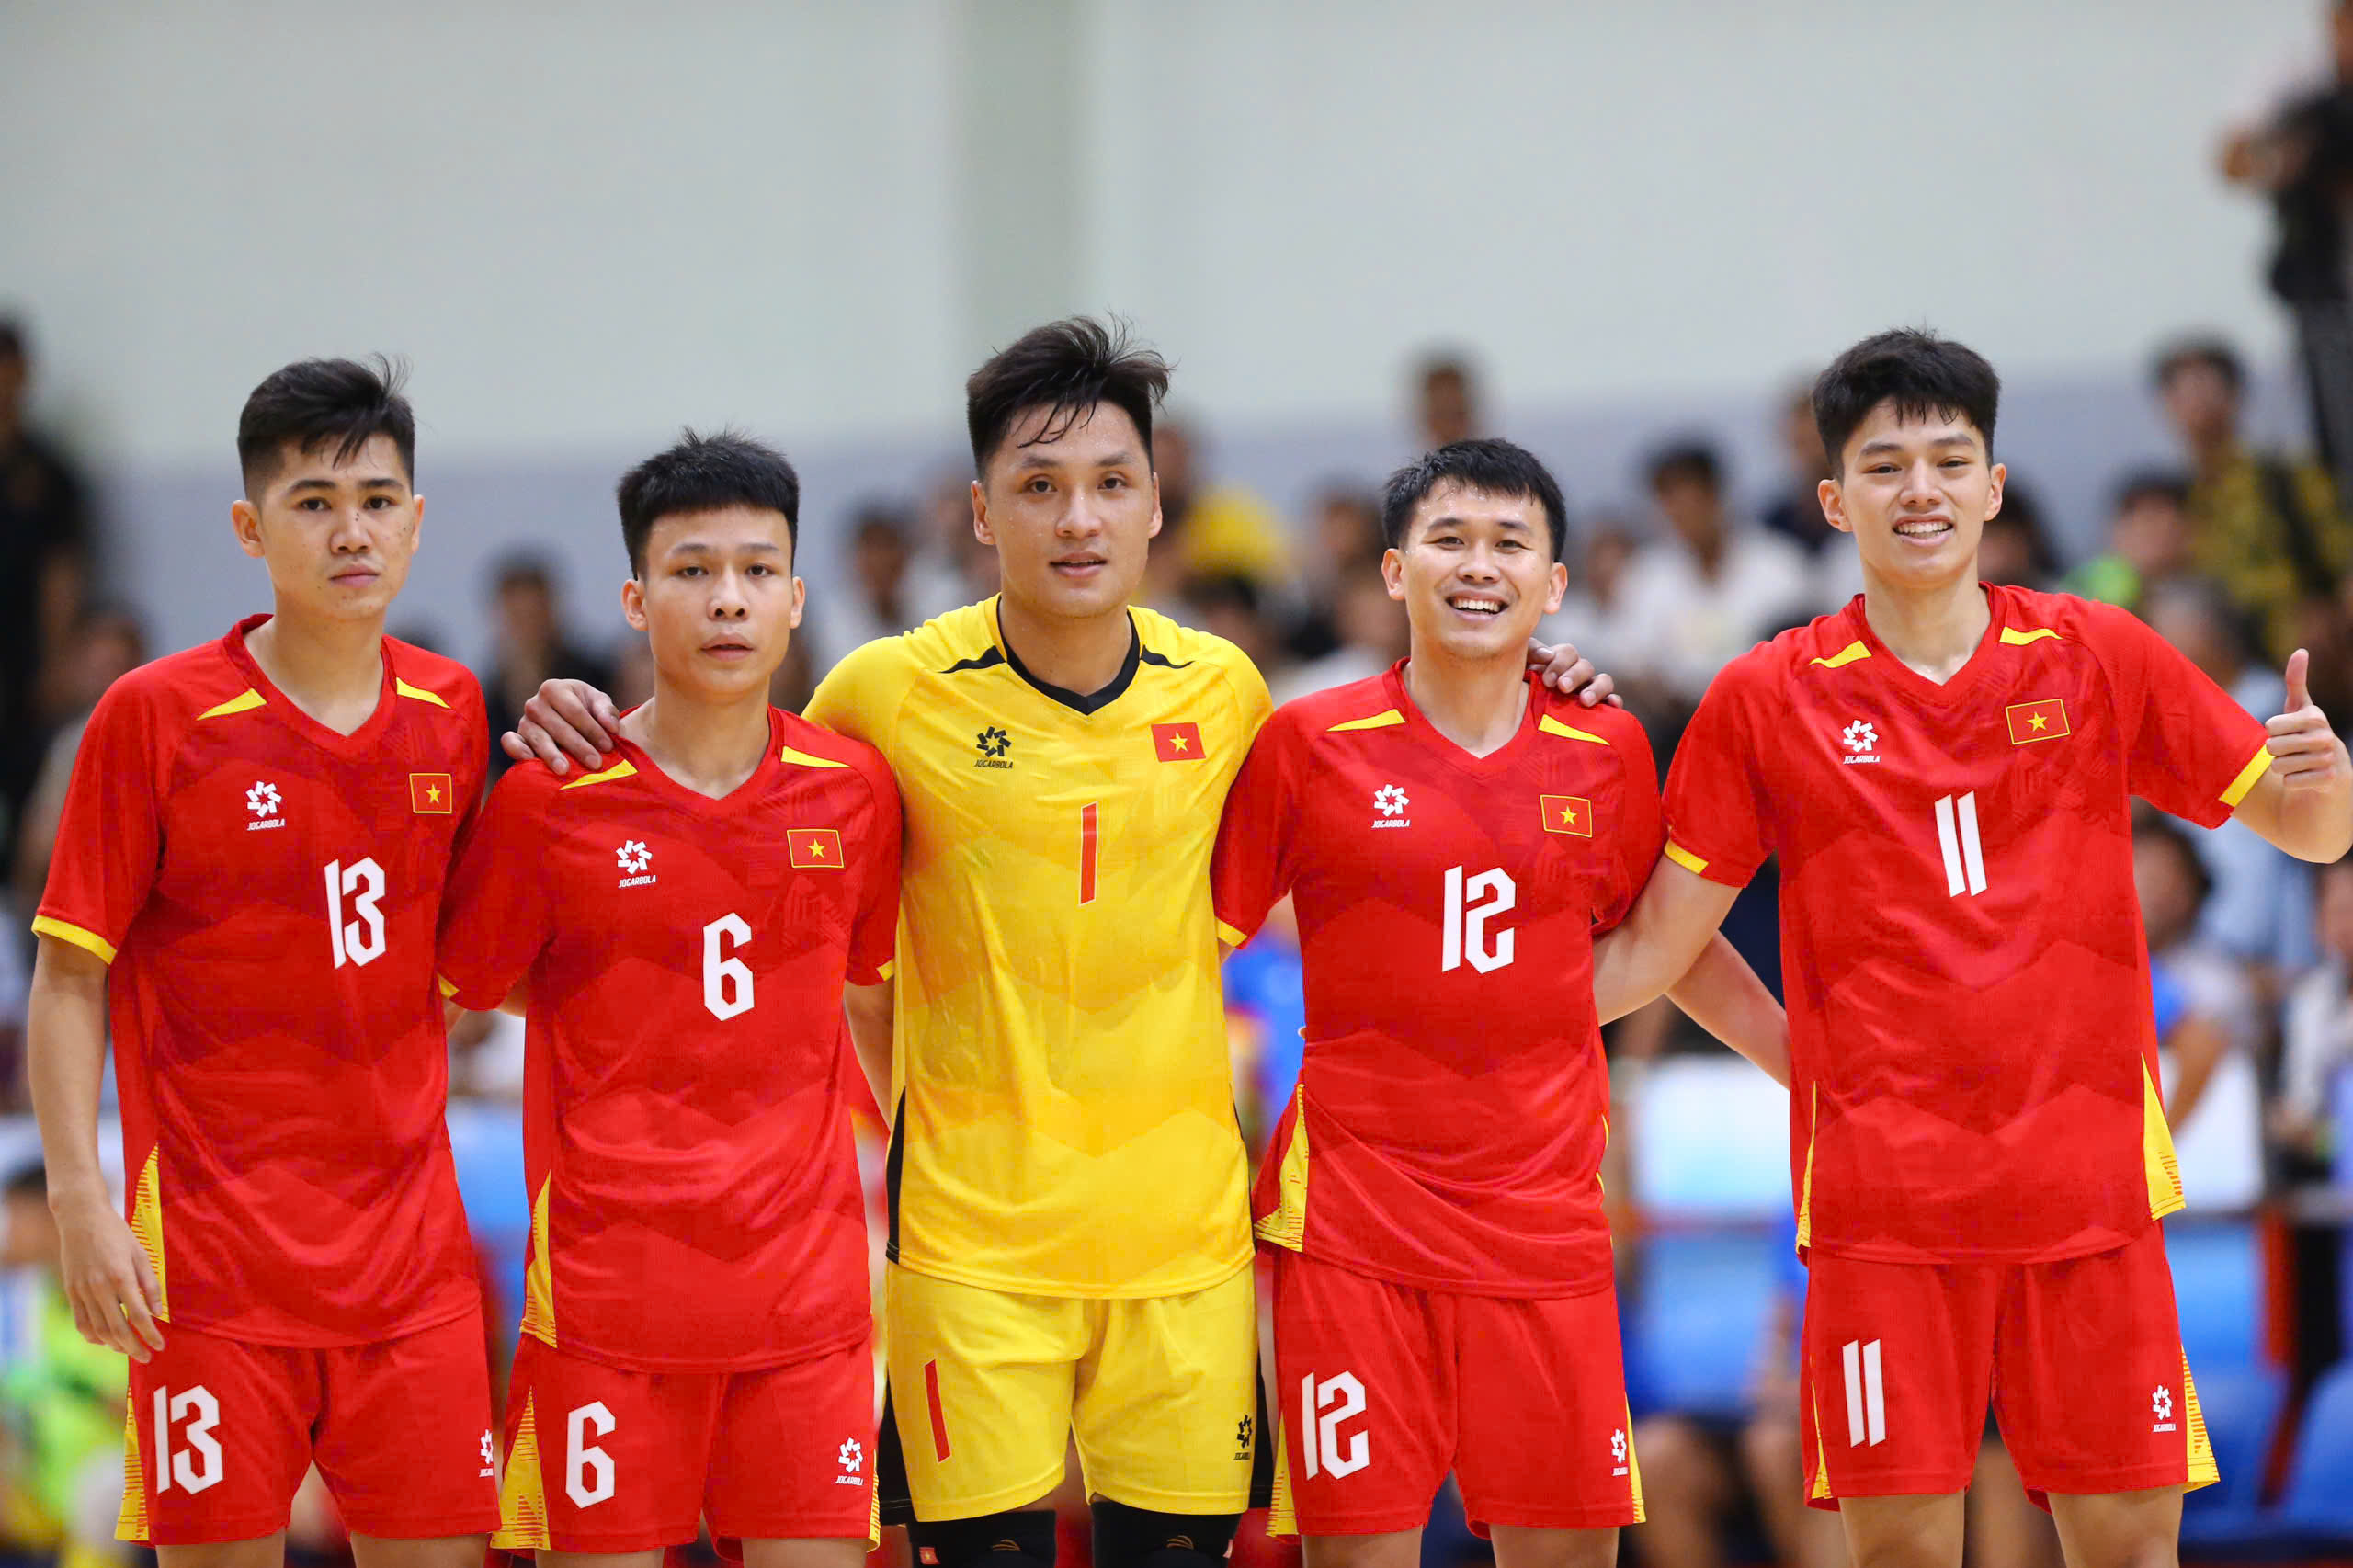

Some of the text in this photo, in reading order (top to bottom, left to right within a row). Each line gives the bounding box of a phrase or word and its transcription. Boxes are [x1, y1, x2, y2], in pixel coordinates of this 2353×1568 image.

[976, 755, 1014, 769] JOGARBOLA
[1842, 754, 1881, 765] JOGARBOLA
[247, 818, 286, 831] JOGARBOLA
[1079, 802, 1098, 906] 1
[1371, 819, 1411, 829] JOGARBOLA
[1934, 790, 1988, 898] 11
[324, 857, 386, 968] 13
[618, 873, 657, 889] JOGARBOLA
[1441, 866, 1516, 974] 12
[702, 913, 754, 1022] 6
[153, 1384, 223, 1495] 13
[924, 1358, 951, 1463] 1
[1302, 1370, 1370, 1480] 12
[1842, 1339, 1886, 1448] 11
[565, 1401, 616, 1509] 6
